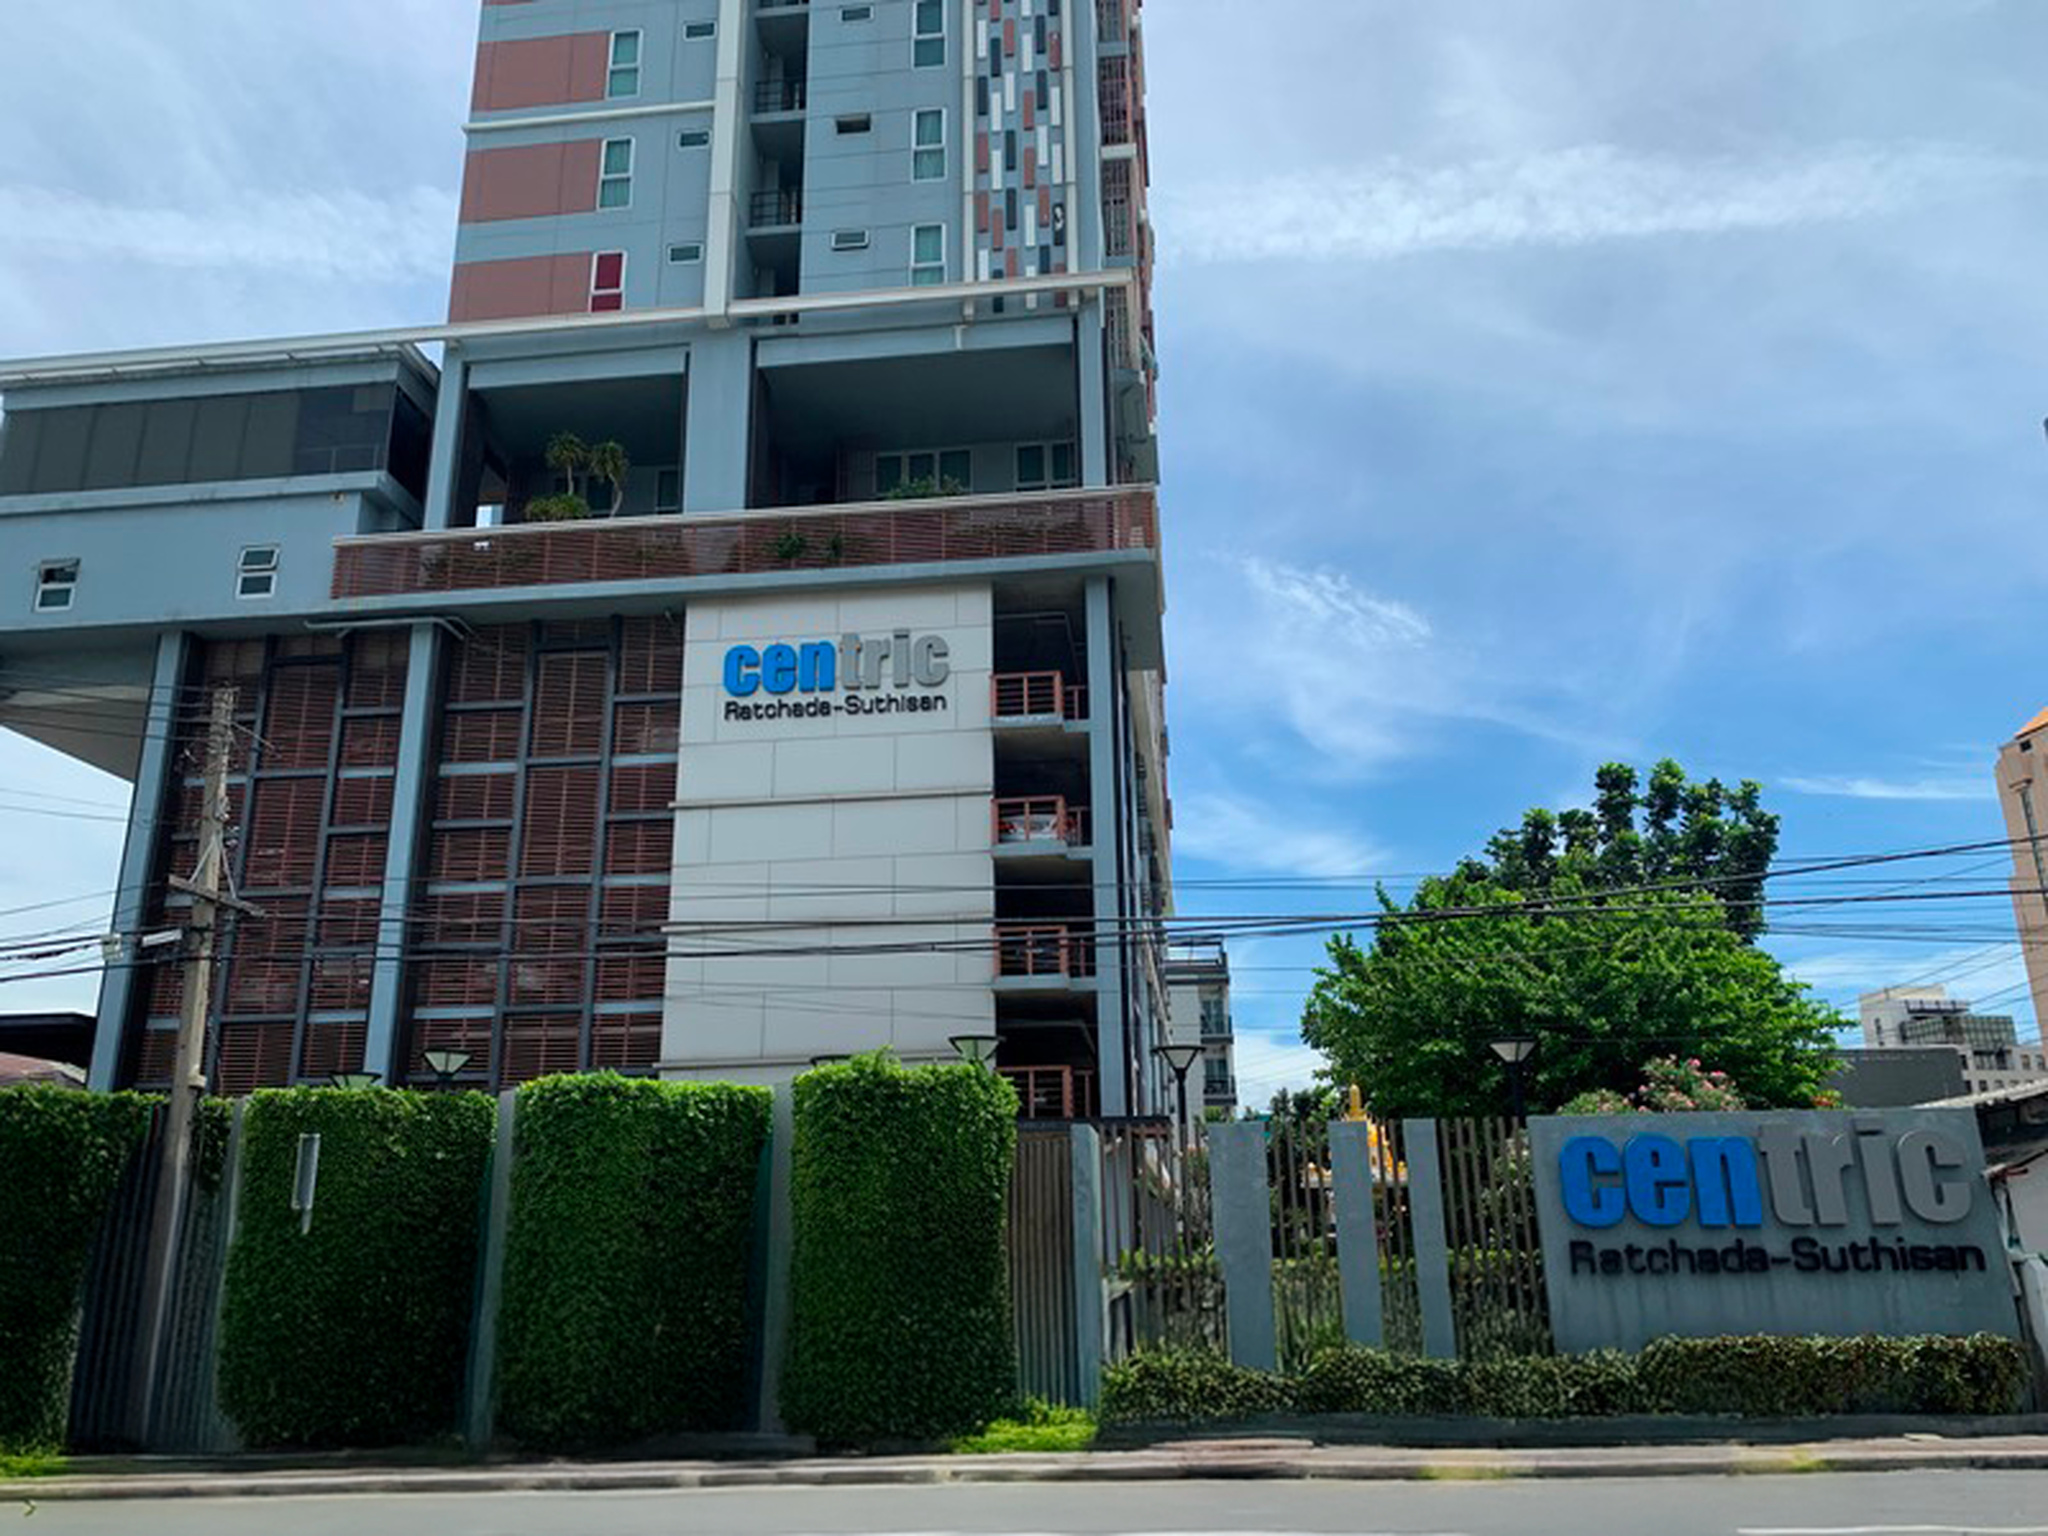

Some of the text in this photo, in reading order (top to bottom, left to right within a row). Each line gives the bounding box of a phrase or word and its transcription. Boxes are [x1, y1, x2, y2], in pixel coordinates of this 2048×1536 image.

[723, 629, 950, 696] centric
[724, 693, 947, 721] Ratchada-Suthisan
[1559, 1119, 1973, 1229] centric
[1569, 1236, 1986, 1277] Ratchada-Suthisan
